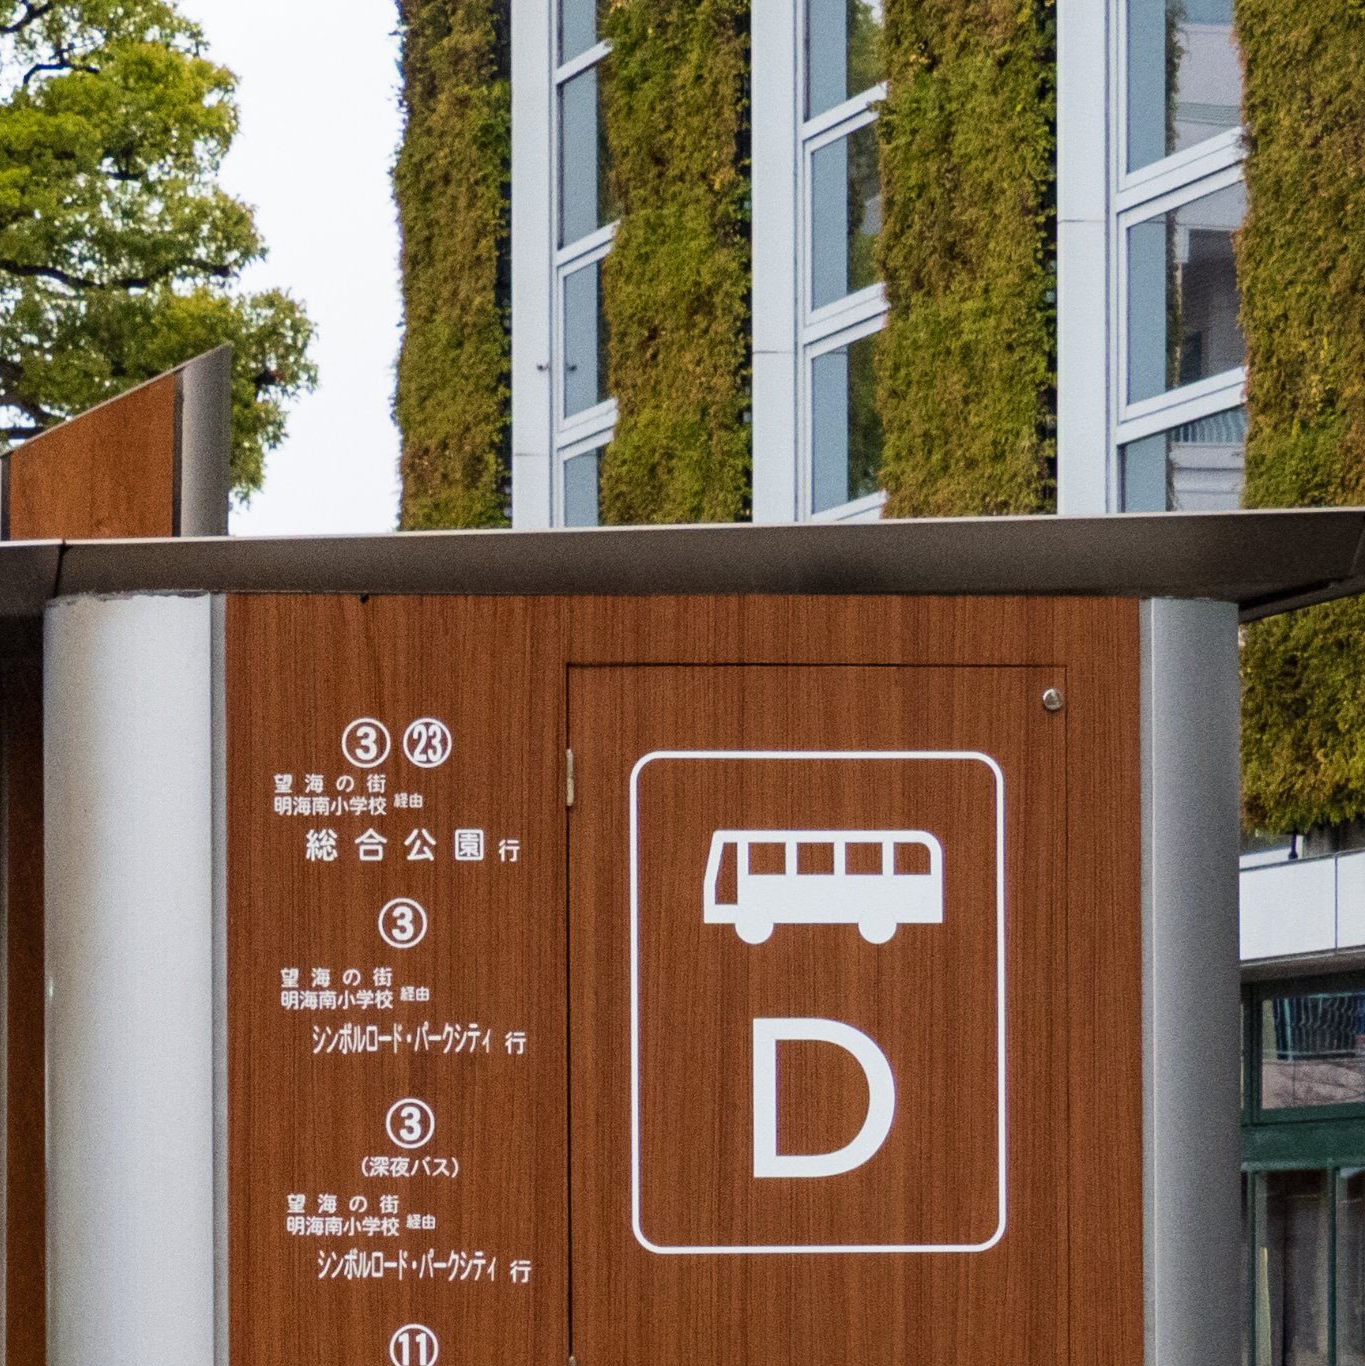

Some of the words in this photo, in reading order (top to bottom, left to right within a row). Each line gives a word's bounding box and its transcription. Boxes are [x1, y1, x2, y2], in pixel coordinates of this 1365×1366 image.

[412, 723, 443, 762] 23
[274, 774, 386, 793] 望海の街
[274, 796, 387, 816] 明海南小学校
[393, 793, 423, 808] 経由
[281, 968, 393, 987] 望海の街
[281, 990, 394, 1010] 明海南小学校
[400, 987, 430, 1002] 経由
[753, 1018, 895, 1178] D
[287, 1194, 399, 1214] 望海の街
[287, 1216, 400, 1237] 明海南小学校
[406, 1213, 436, 1230] 経由
